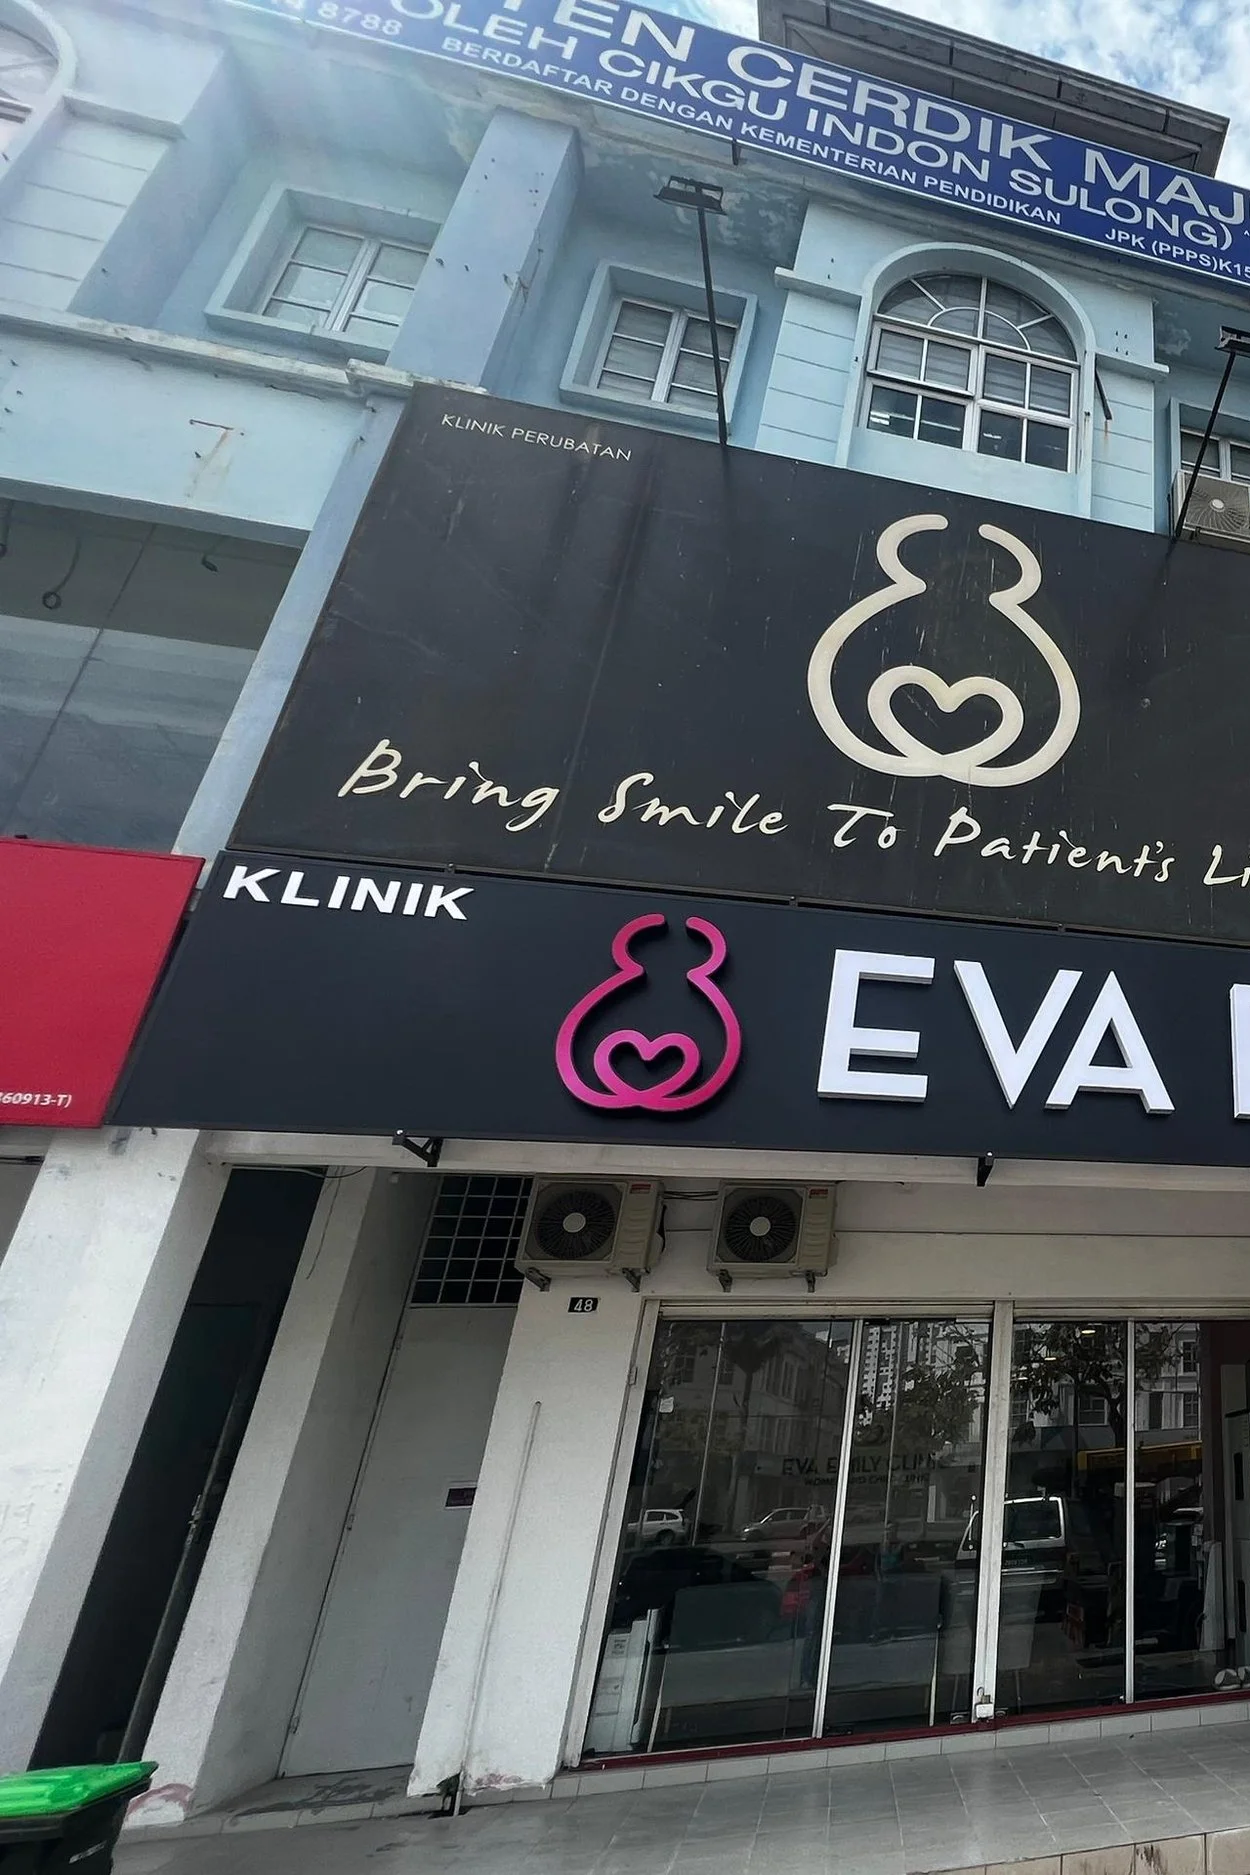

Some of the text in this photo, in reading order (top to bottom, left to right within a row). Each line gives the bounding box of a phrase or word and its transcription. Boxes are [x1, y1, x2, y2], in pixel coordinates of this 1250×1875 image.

[317, 2, 403, 36] 8788
[503, 0, 695, 62] EN
[727, 45, 1053, 171] CERDIK
[441, 36, 1061, 225] BERDAFTAR DENGAN KEMENTERIAN PENDIDIKAN
[600, 49, 787, 120] CIKGU
[806, 109, 989, 182] INDON
[1008, 167, 1232, 251] SULONG)
[1105, 228, 1146, 251] JPK
[441, 414, 632, 461] KLINIK PERUBATAN
[337, 739, 560, 832] Bring
[598, 772, 789, 835] Smile
[827, 803, 905, 848] To
[933, 806, 1175, 883] Patient's
[223, 865, 475, 920] KLINIK
[817, 948, 1175, 1114] EVA
[0, 1091, 72, 1109] 60913-T)
[573, 1299, 593, 1312] 48
